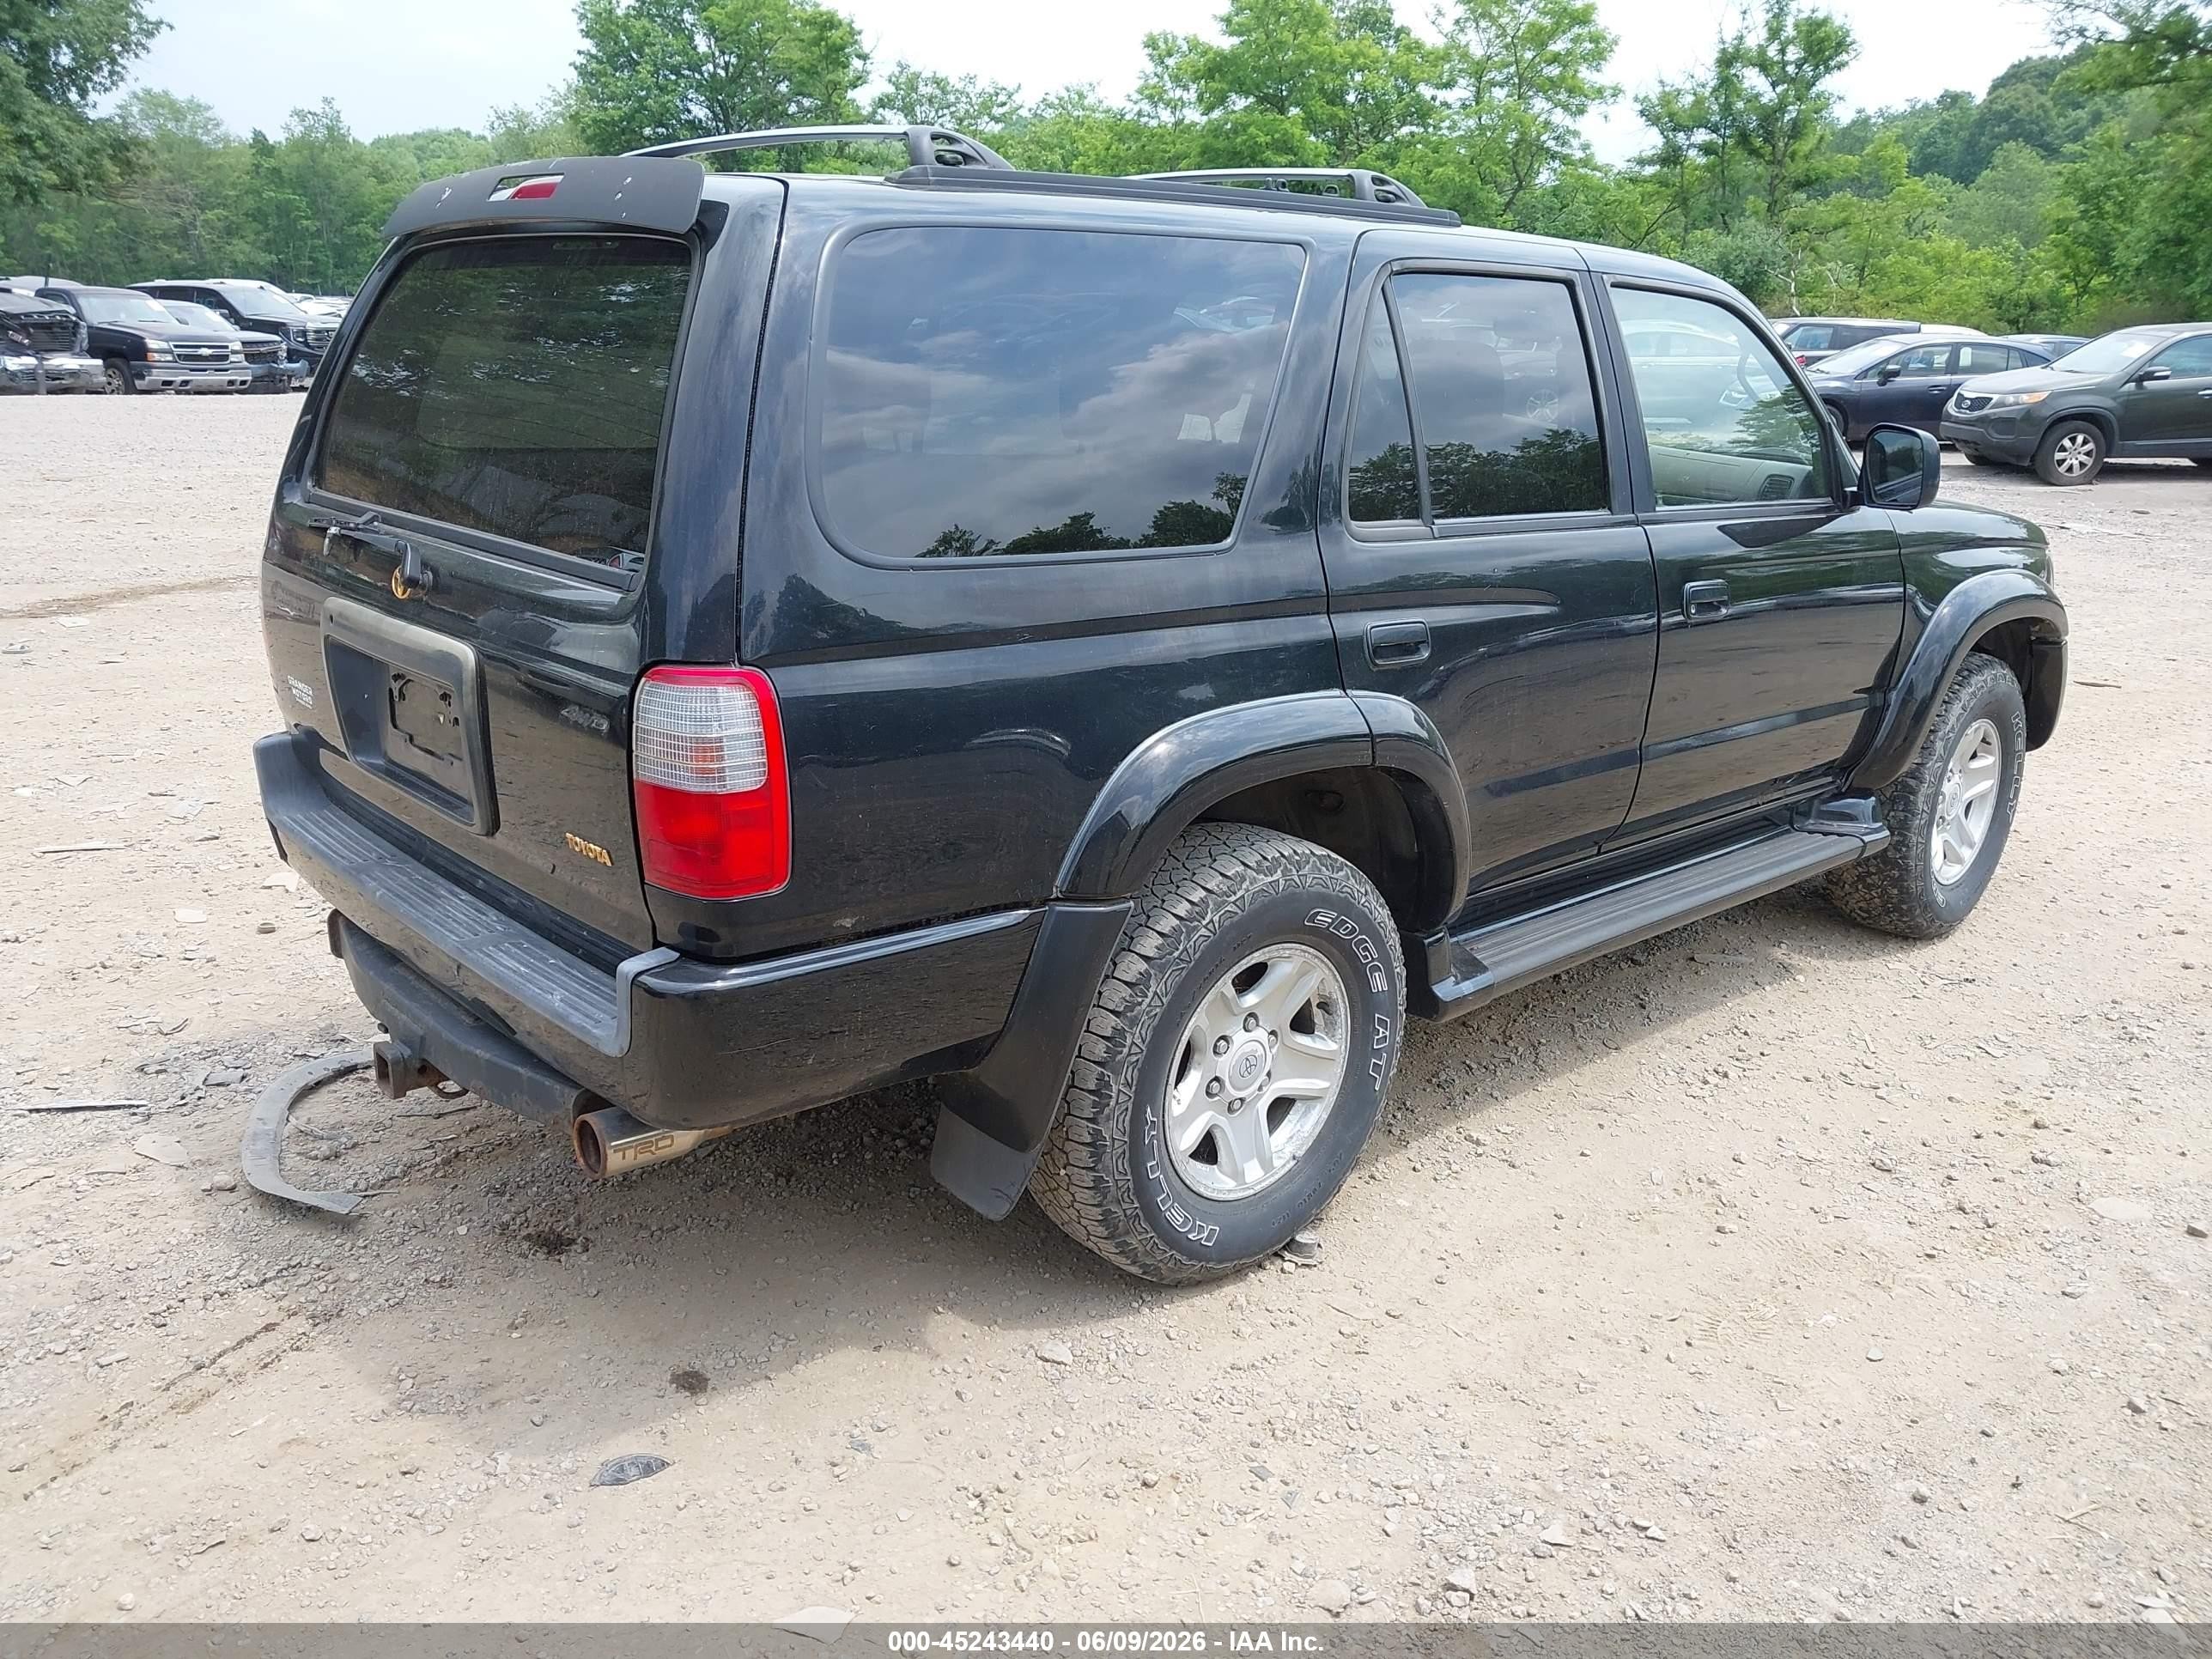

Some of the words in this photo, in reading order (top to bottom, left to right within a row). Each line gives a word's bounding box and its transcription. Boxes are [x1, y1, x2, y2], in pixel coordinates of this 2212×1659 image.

[2007, 711, 2023, 823] KELLY
[565, 831, 613, 867] TOYOTA
[1304, 907, 1389, 993] EDGE
[1369, 1013, 1390, 1091] AT
[612, 1133, 675, 1162] TRD
[1145, 1104, 1219, 1246] KELLY
